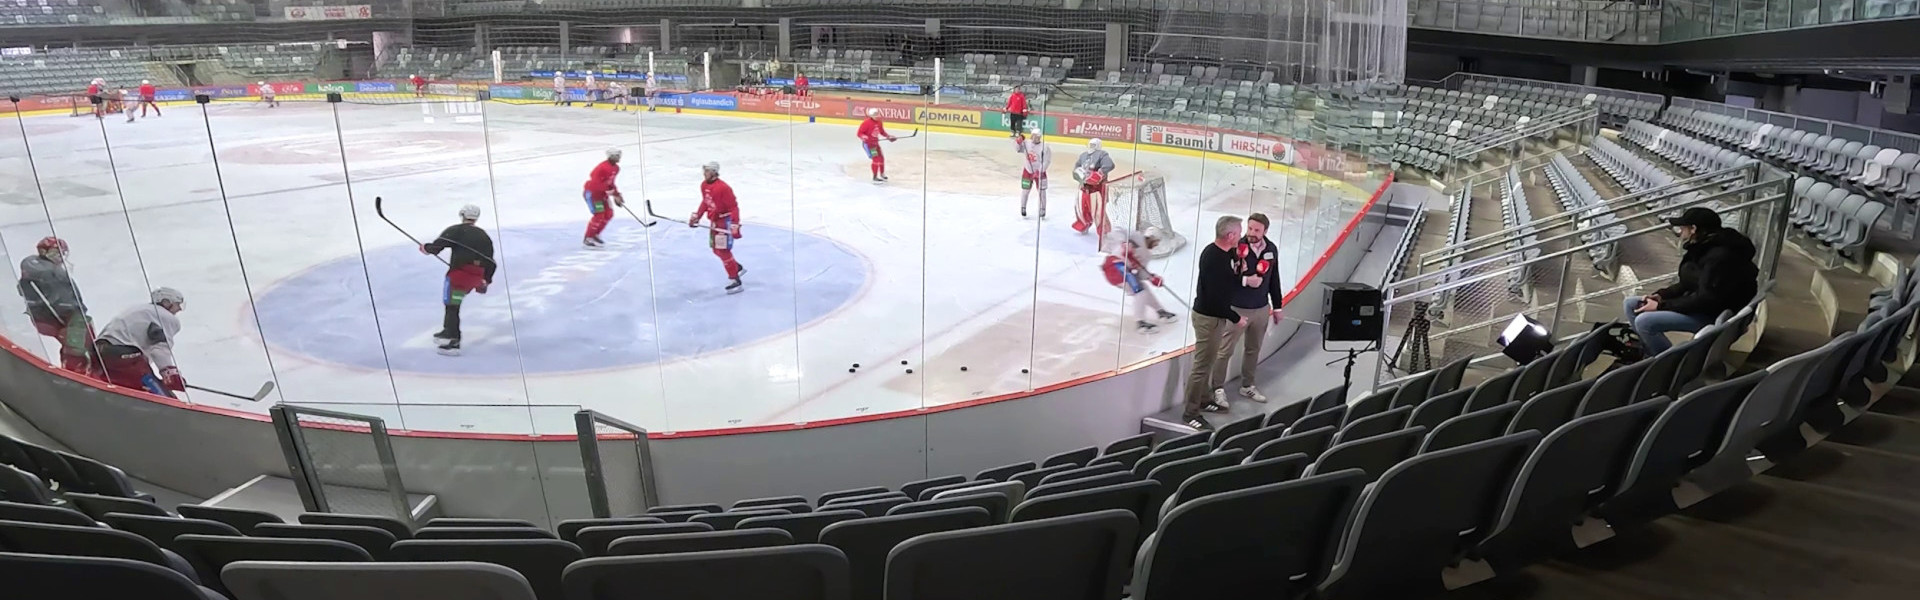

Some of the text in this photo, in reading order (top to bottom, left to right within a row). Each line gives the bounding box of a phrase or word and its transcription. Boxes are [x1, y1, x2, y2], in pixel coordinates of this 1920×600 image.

[918, 110, 978, 125] ADMIRAL
[1001, 113, 1038, 130] kag
[1085, 122, 1122, 133] JAMNIG
[1230, 140, 1270, 155] HIRSCH
